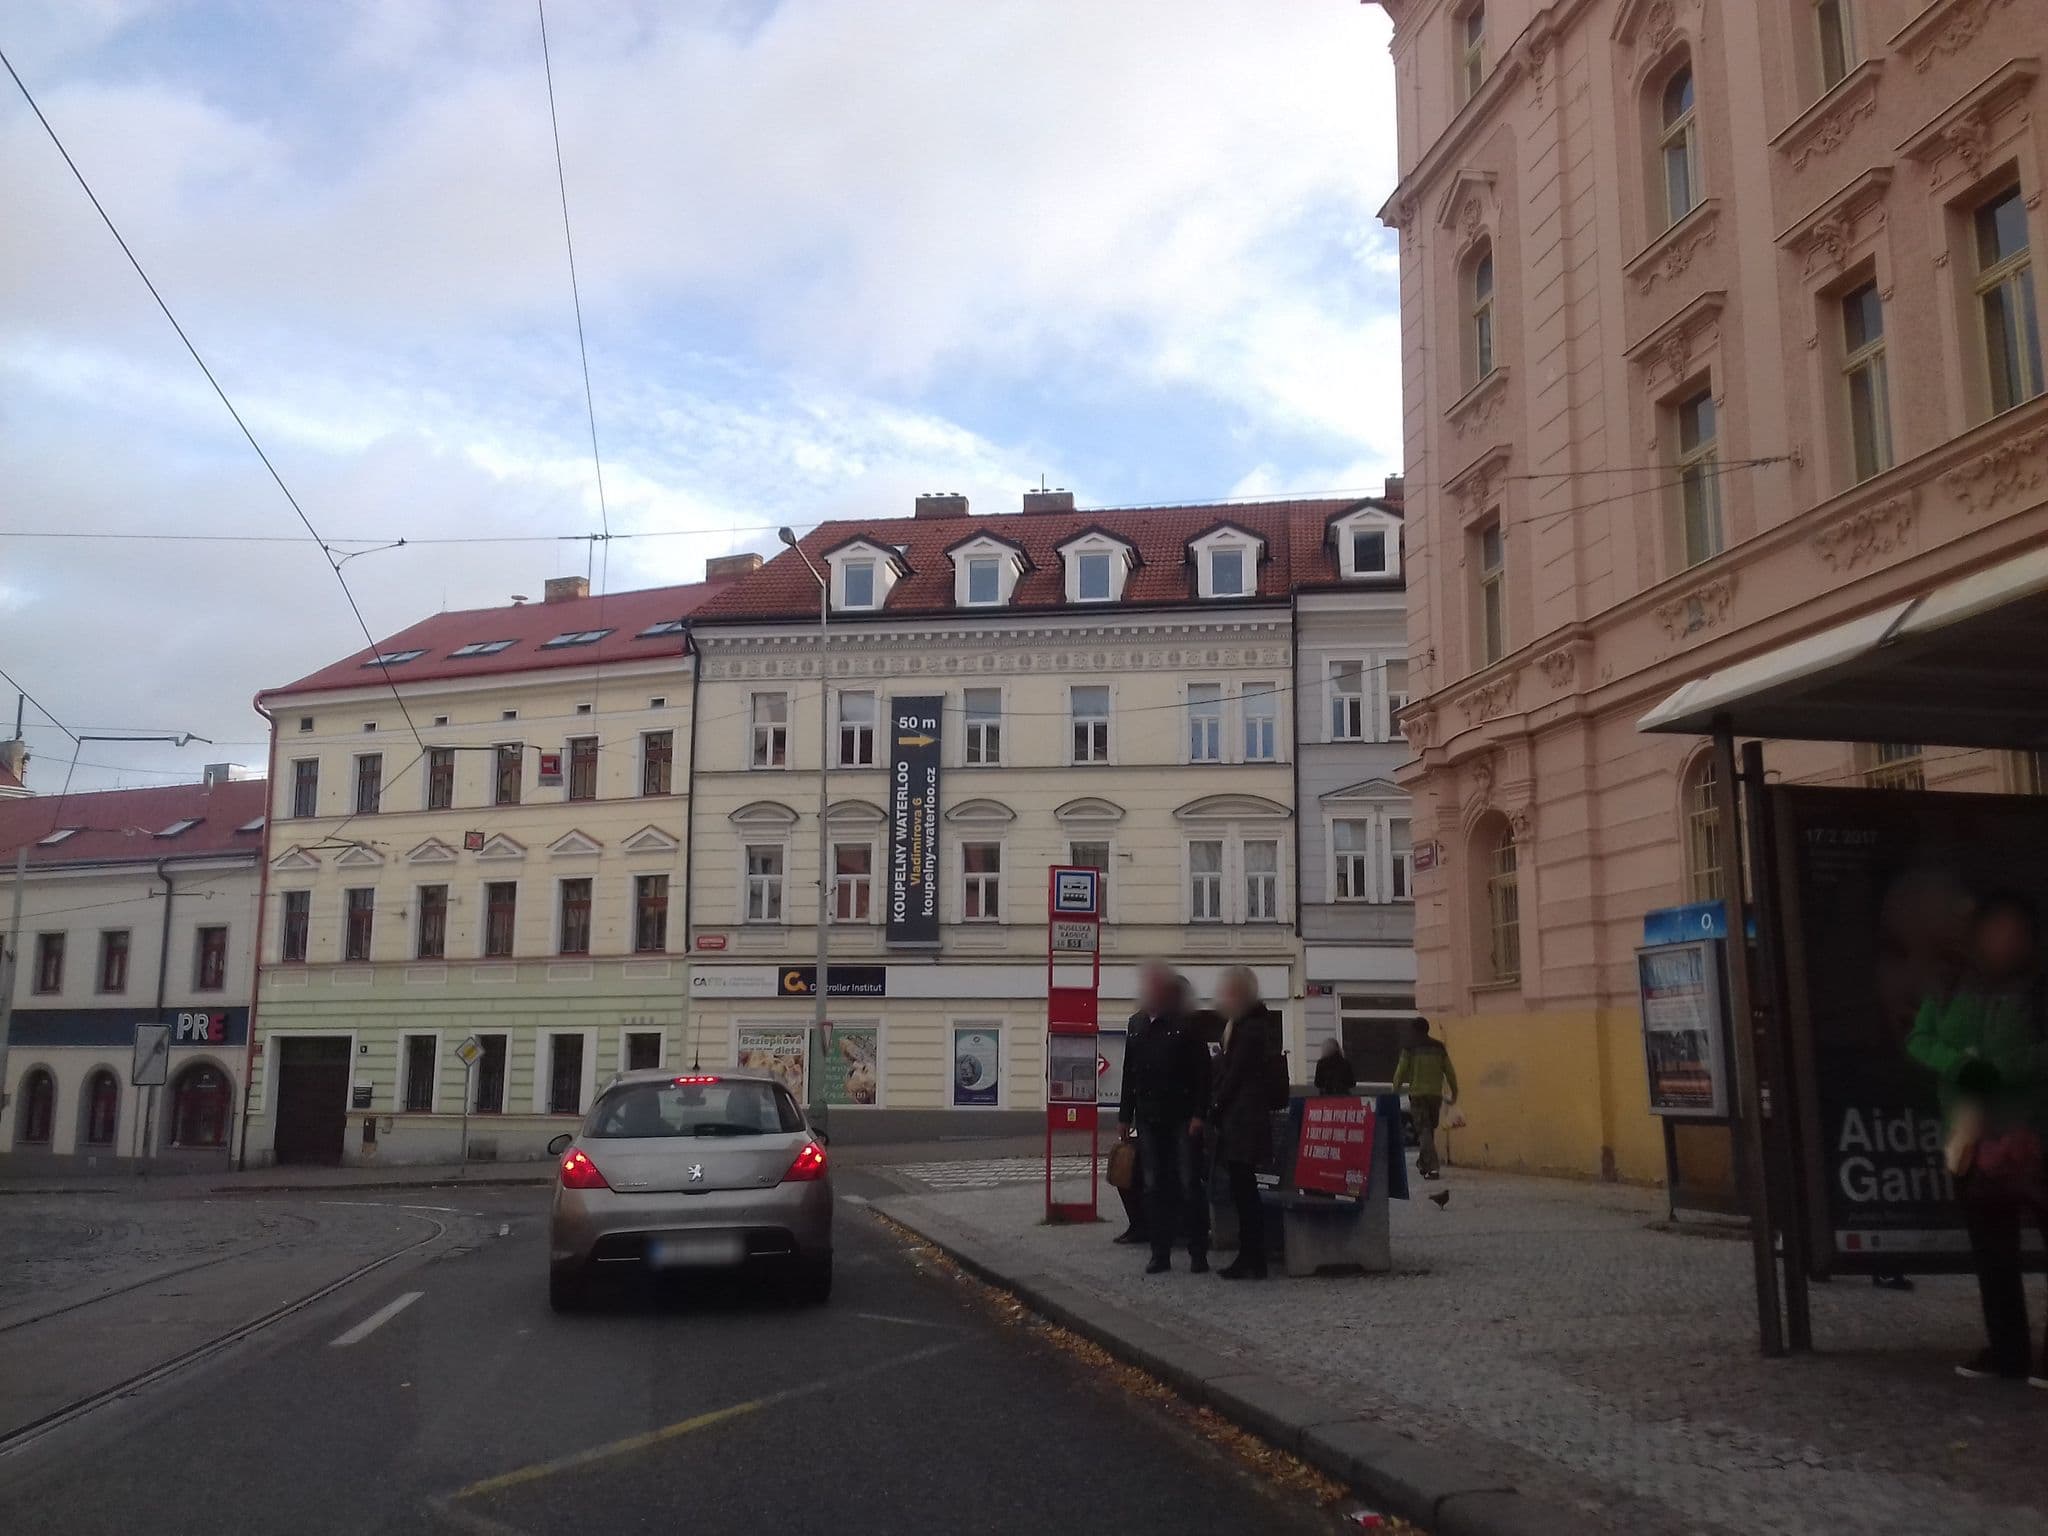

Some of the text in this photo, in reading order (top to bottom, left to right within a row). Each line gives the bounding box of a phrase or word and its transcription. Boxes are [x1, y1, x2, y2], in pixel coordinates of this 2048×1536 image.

[898, 716, 936, 729] 50 m
[912, 797, 922, 807] 6
[894, 761, 909, 923] KOUPELNY WATERLOO
[922, 767, 937, 916] koupelny-waterloo.cz
[852, 982, 883, 993] Institut
[176, 1013, 225, 1041] PRE
[774, 1046, 802, 1055] dieta
[1839, 1106, 1943, 1152] Aida
